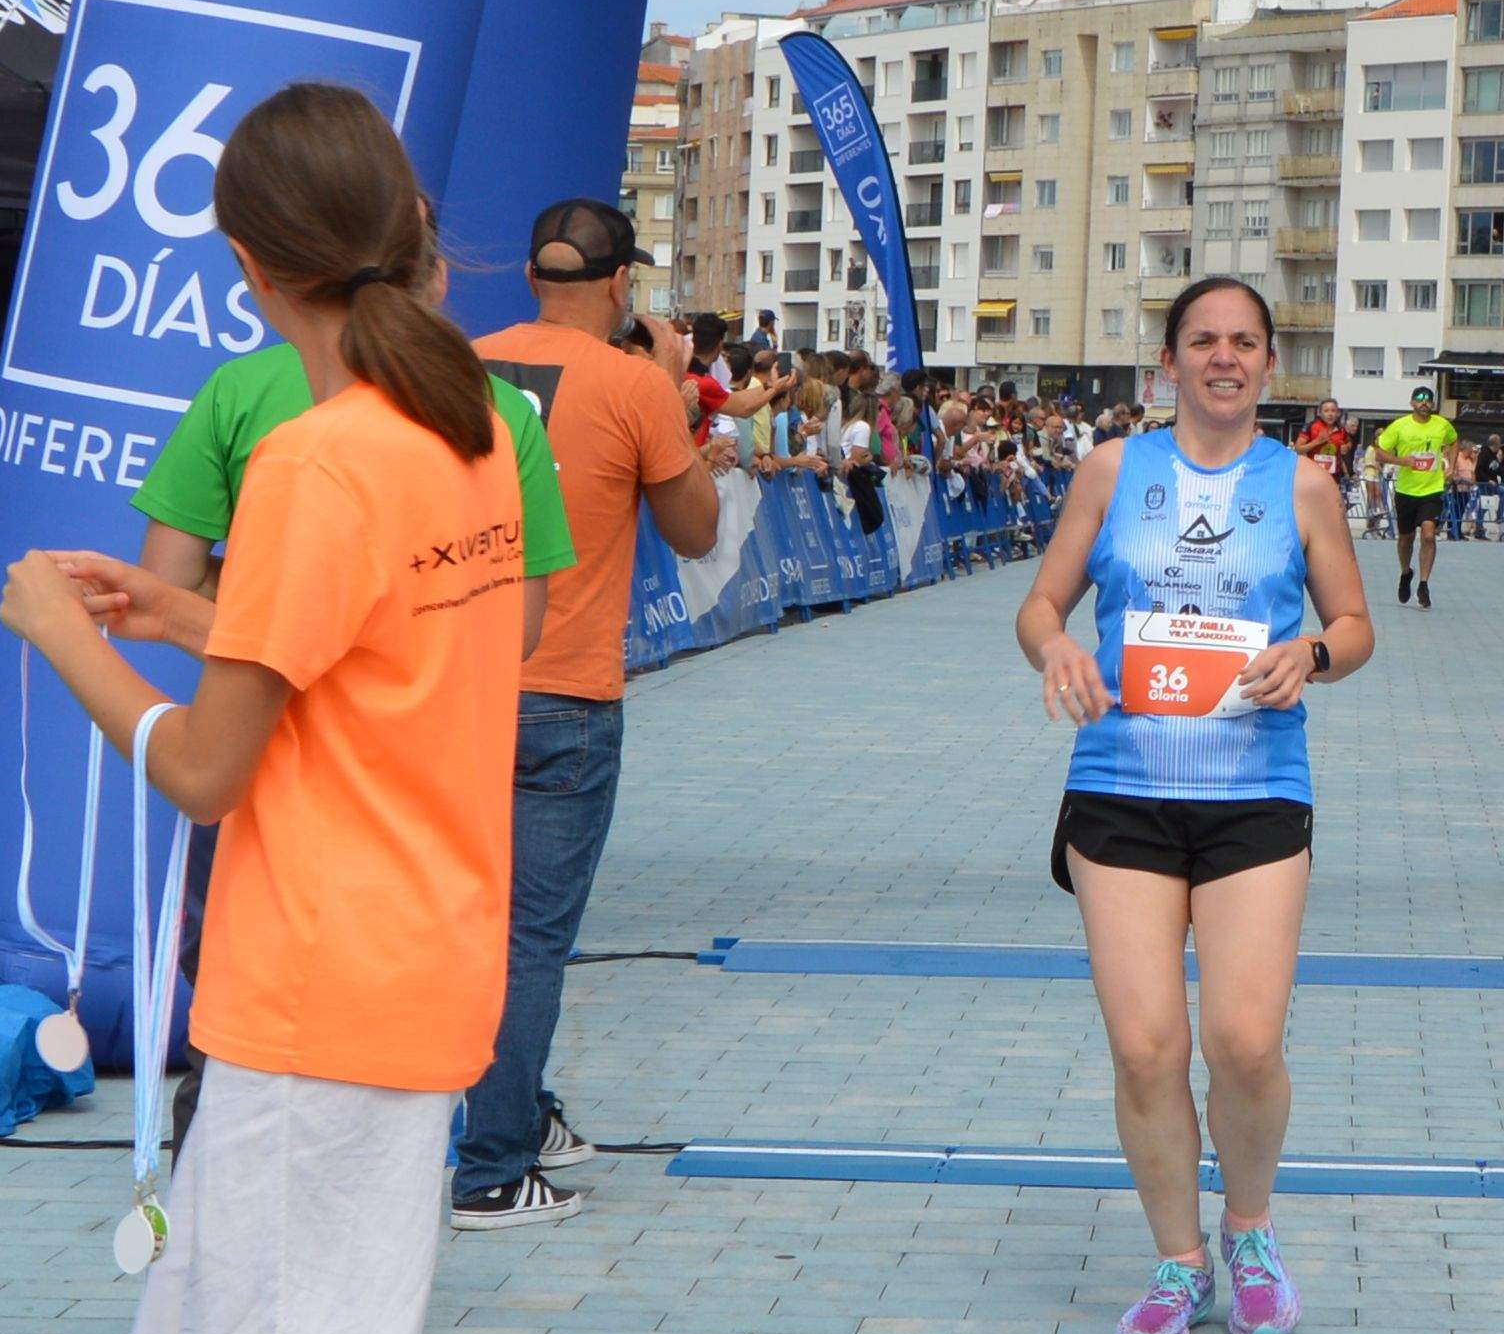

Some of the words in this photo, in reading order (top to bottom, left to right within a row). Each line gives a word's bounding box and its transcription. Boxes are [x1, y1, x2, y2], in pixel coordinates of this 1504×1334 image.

[821, 95, 854, 130] 365
[56, 64, 234, 238] 36
[80, 247, 265, 354] DÍAS
[1169, 619, 1196, 629] XXV
[1200, 621, 1235, 633] MILLA
[1149, 663, 1189, 691] 36
[1148, 687, 1189, 702] Gloria
